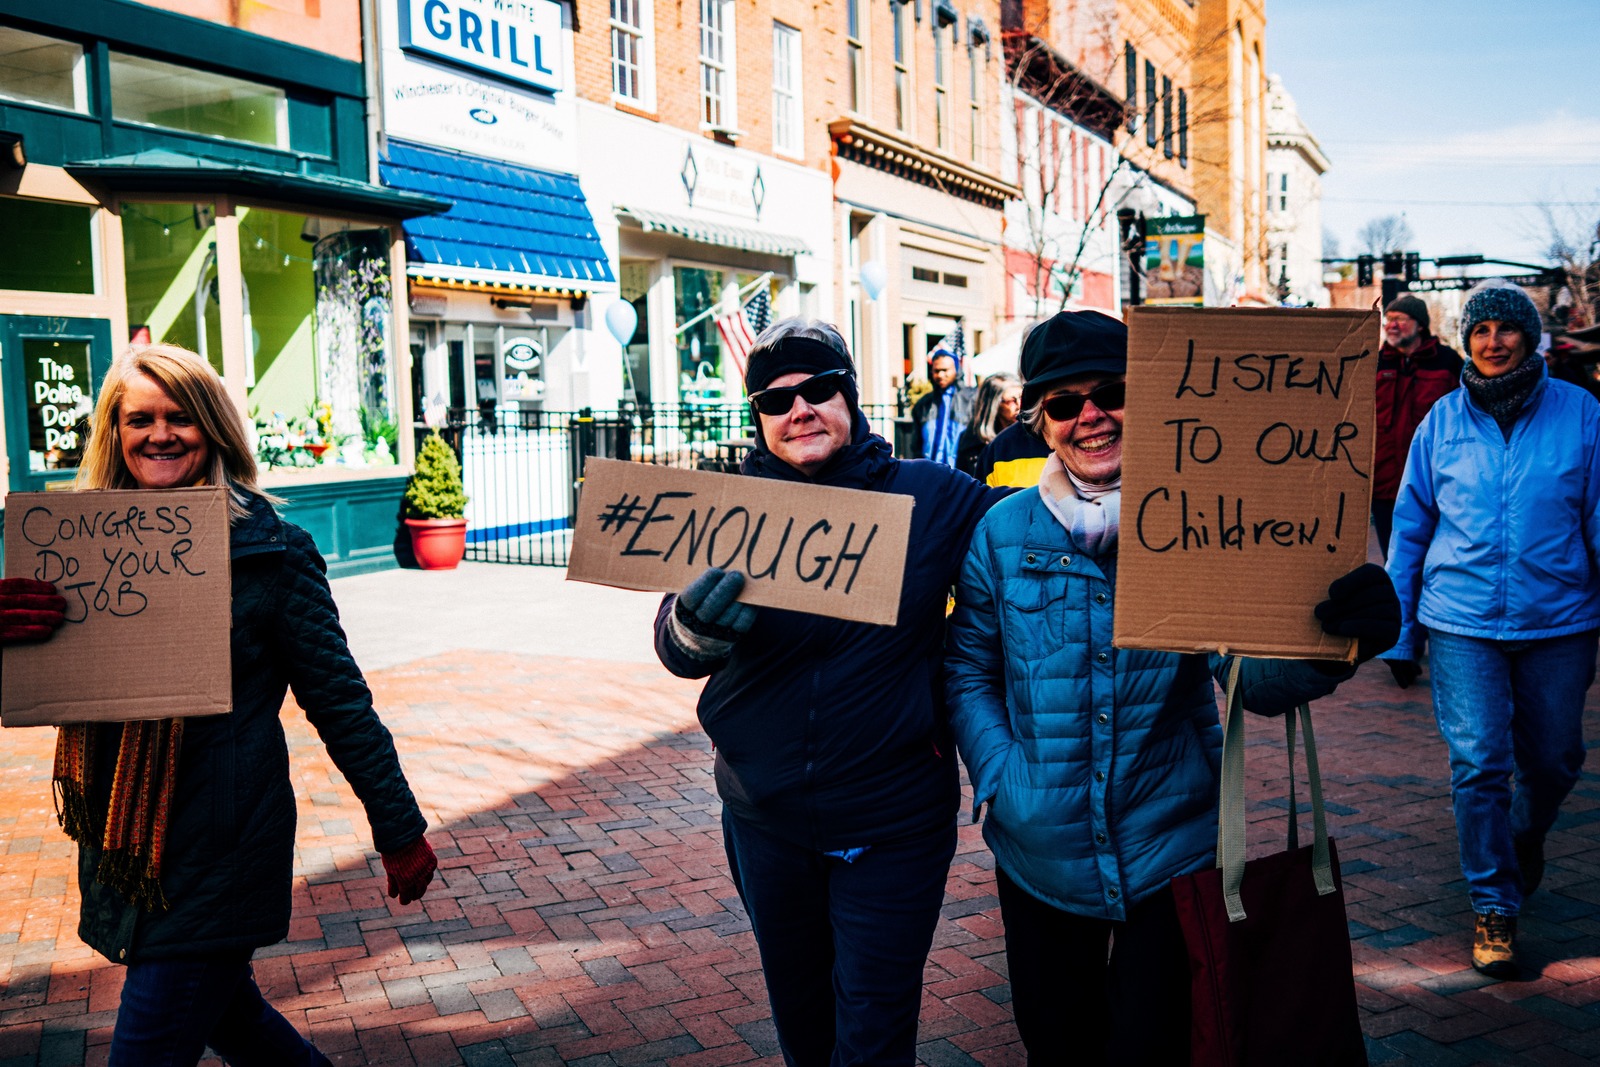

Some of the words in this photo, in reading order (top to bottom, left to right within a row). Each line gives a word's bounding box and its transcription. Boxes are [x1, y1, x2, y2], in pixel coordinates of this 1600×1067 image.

[423, 0, 553, 75] GRILL
[34, 381, 83, 404] Polka
[38, 357, 75, 381] The
[1175, 339, 1370, 399] LISTEN
[42, 404, 77, 427] Dot
[45, 428, 77, 450] Pot
[1164, 418, 1222, 473] TO
[1256, 421, 1369, 479] OUR
[22, 506, 192, 547] CONGRESS
[597, 491, 879, 594] #ENOUGH
[1136, 486, 1345, 553] Children!
[103, 538, 206, 590] YOUR
[64, 580, 148, 623] JOB
